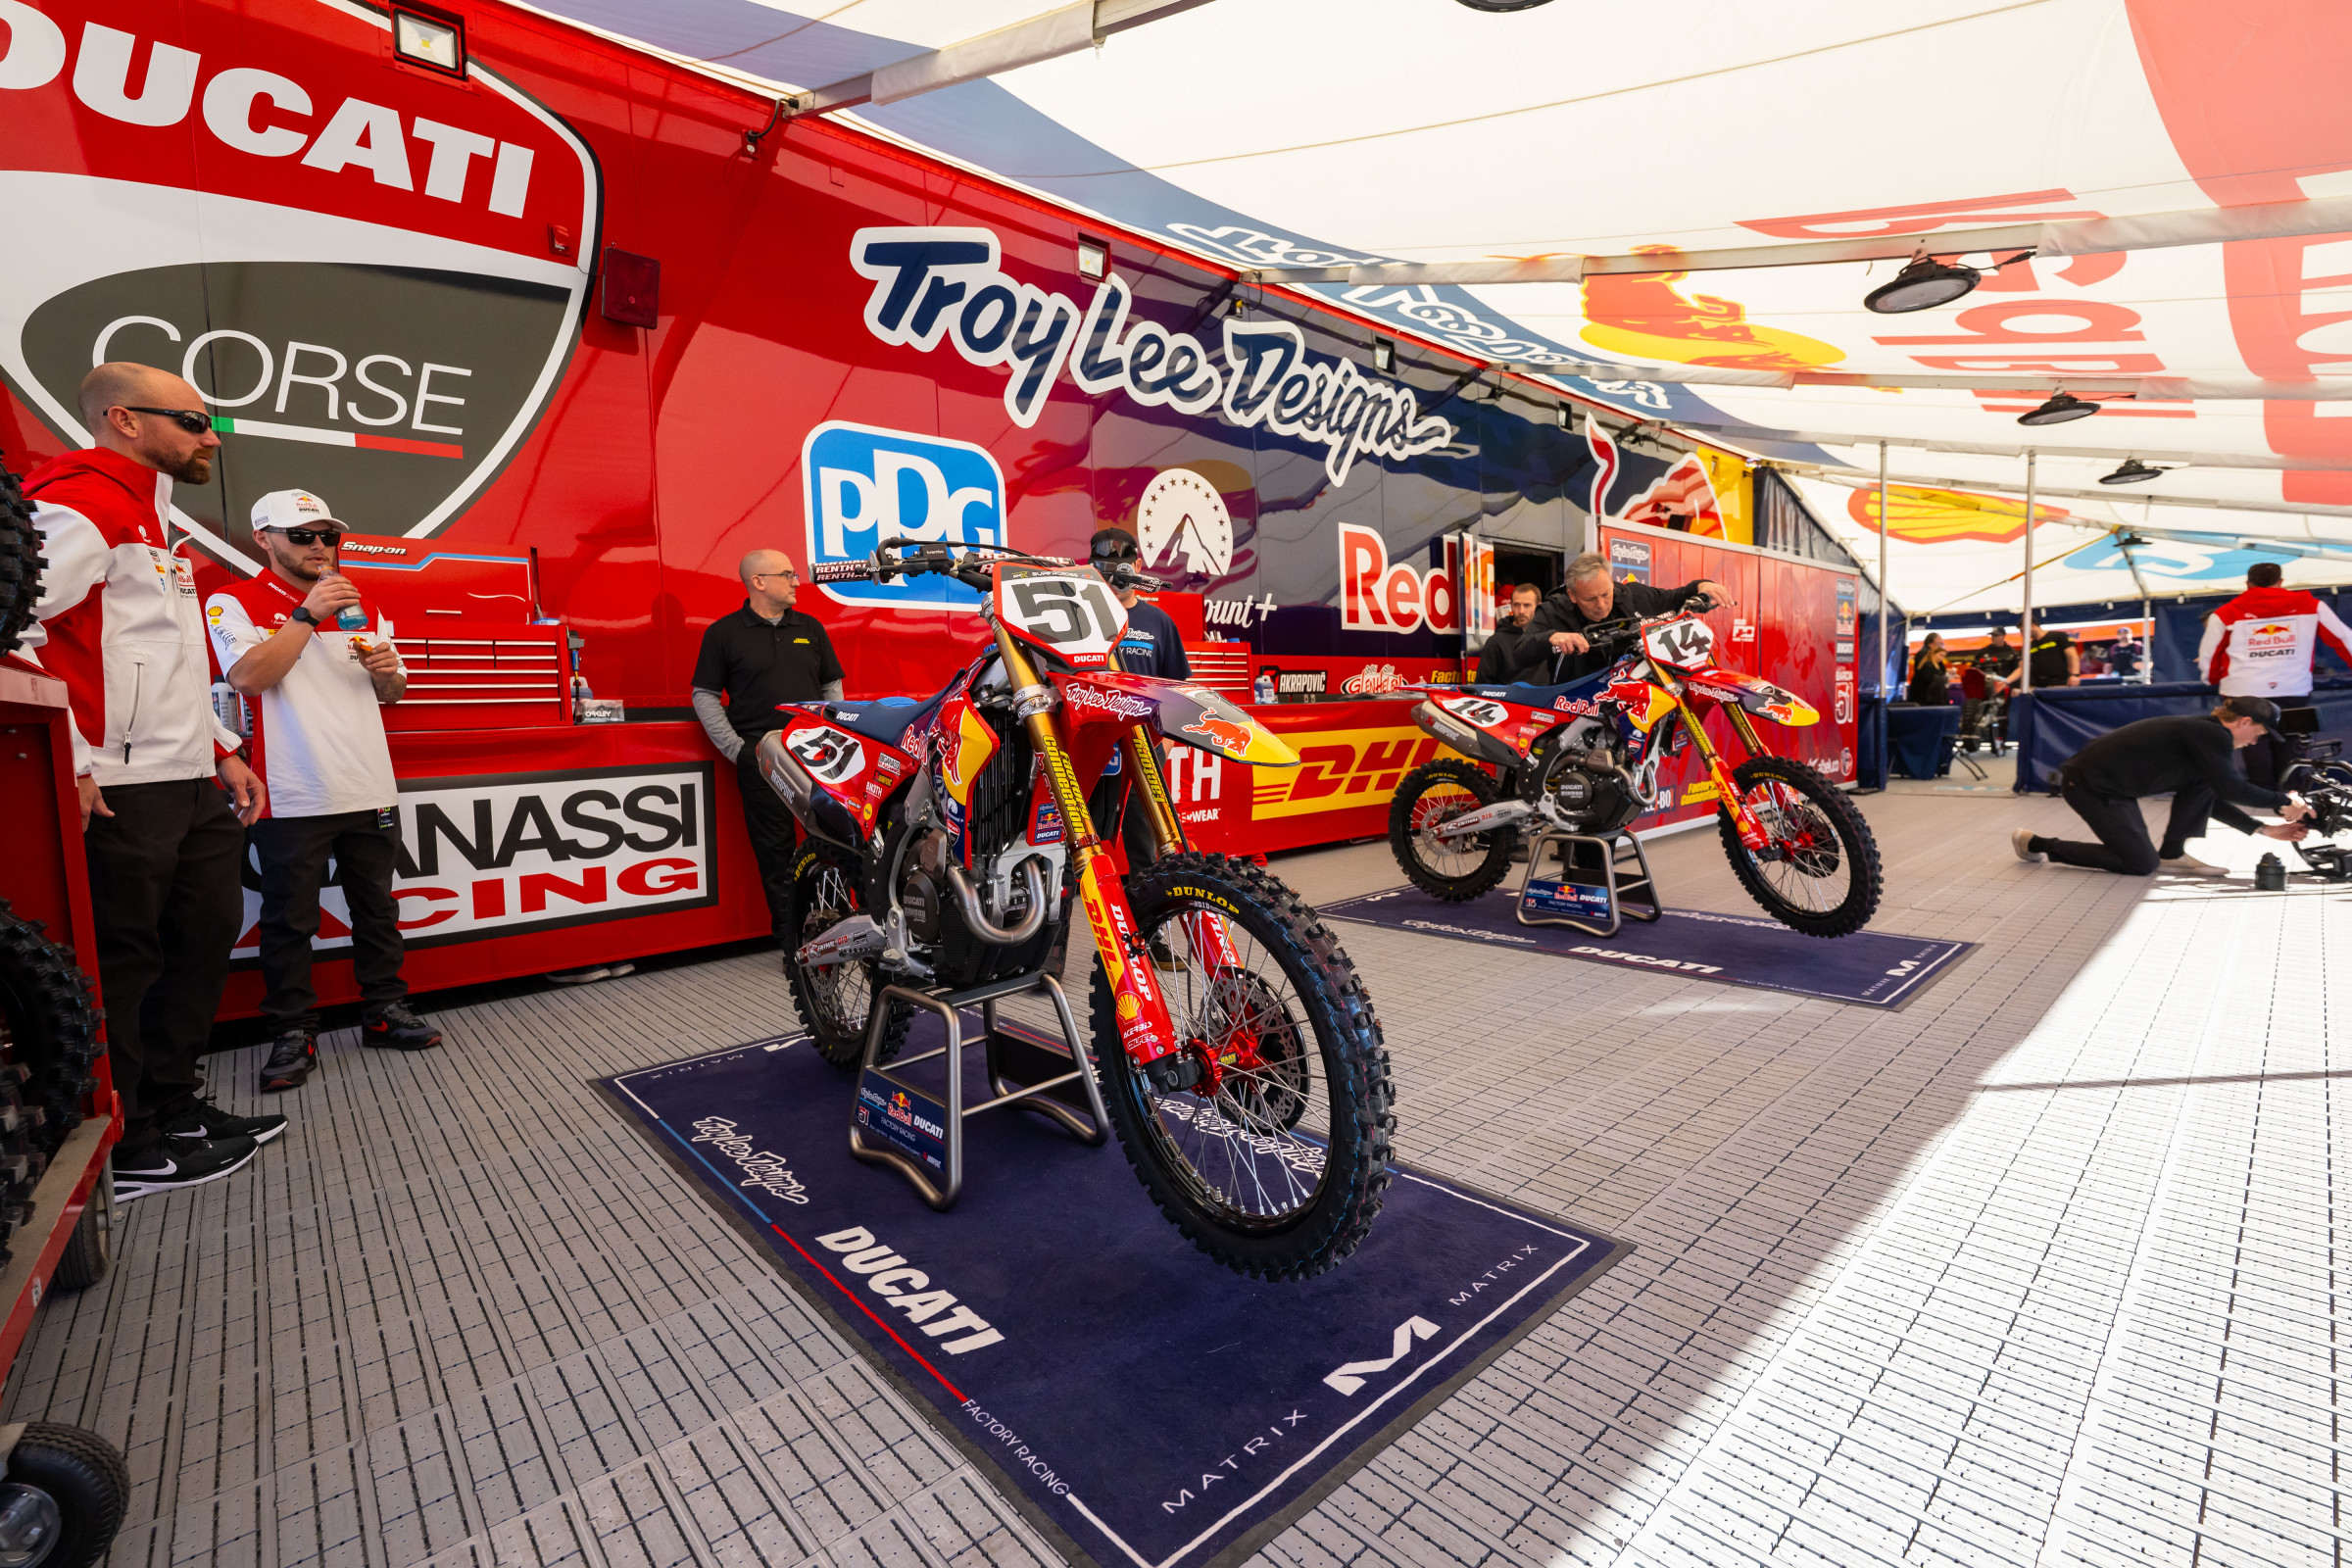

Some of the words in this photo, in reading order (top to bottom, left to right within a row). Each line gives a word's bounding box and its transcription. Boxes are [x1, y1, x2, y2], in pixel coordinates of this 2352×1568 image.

[850, 226, 1081, 428] Troy
[1069, 272, 1221, 416] Lee
[1224, 318, 1452, 487] Designs
[92, 315, 473, 436] CORSE
[819, 448, 995, 588] PPG
[340, 541, 407, 556] Snap-on
[1339, 522, 1461, 635] Red
[1011, 580, 1121, 643] 51
[1657, 622, 1712, 663] 14
[2249, 648, 2296, 658] DUCATI
[1073, 655, 1104, 663] DUCATI
[584, 710, 612, 718] OAKLEY
[835, 710, 860, 722] DUCATI
[1553, 695, 1581, 714] Red
[865, 781, 883, 797] BN3TH
[1036, 829, 1060, 840] DUCATI
[903, 895, 925, 907] DUCATI
[1172, 886, 1241, 914] DUNLOP
[1579, 894, 1608, 905] DUCATI
[1109, 903, 1153, 1003] DULOP
[1568, 945, 1726, 975] DUCATI
[858, 1105, 870, 1126] 51
[913, 1114, 945, 1140] DUCATI
[1448, 1244, 1540, 1307] MATRIX
[814, 1225, 1005, 1356] DUCATI
[961, 1398, 1021, 1453] FACTORY
[1013, 1441, 1070, 1496] RACING
[1160, 1408, 1308, 1515] MATRIX
